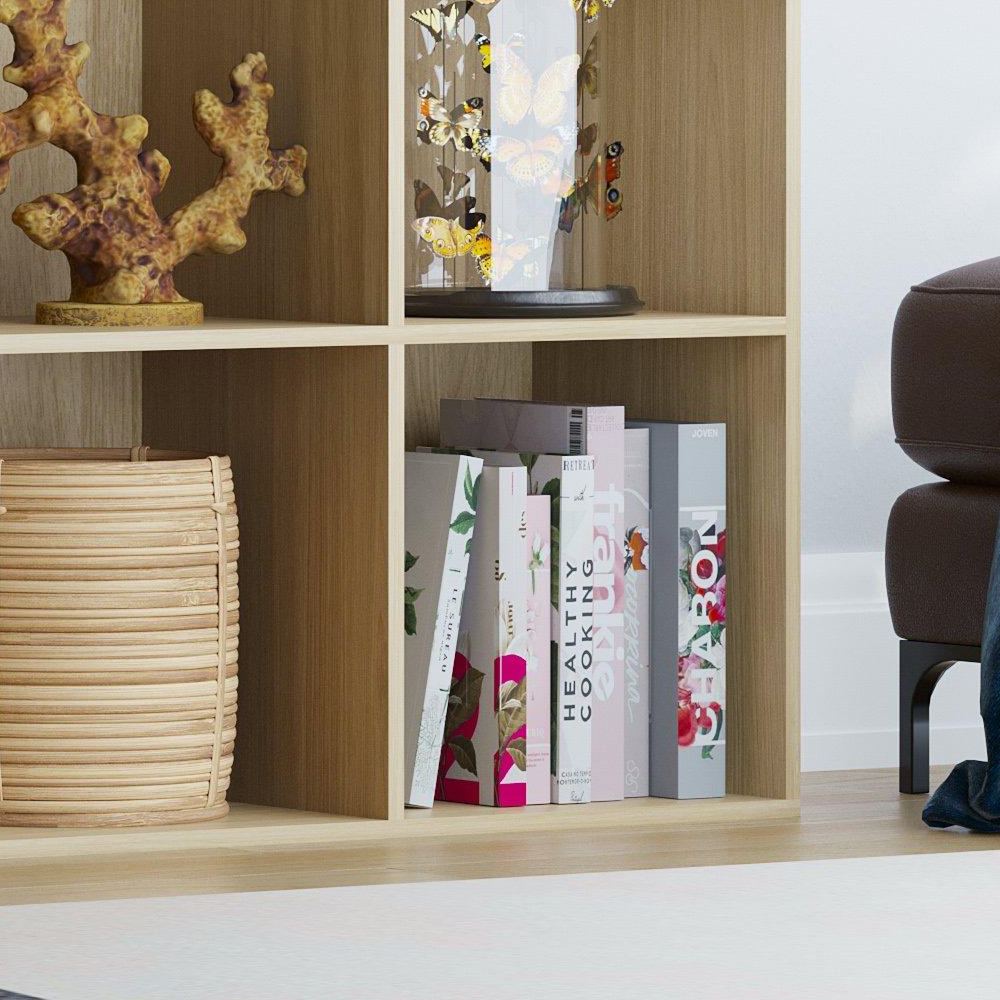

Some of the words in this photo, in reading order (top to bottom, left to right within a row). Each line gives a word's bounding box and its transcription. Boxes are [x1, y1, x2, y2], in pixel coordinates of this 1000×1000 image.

[691, 428, 719, 439] JOVEN
[563, 561, 578, 722] HEALTHY
[580, 559, 594, 722] COOKING
[592, 483, 625, 702] frankie
